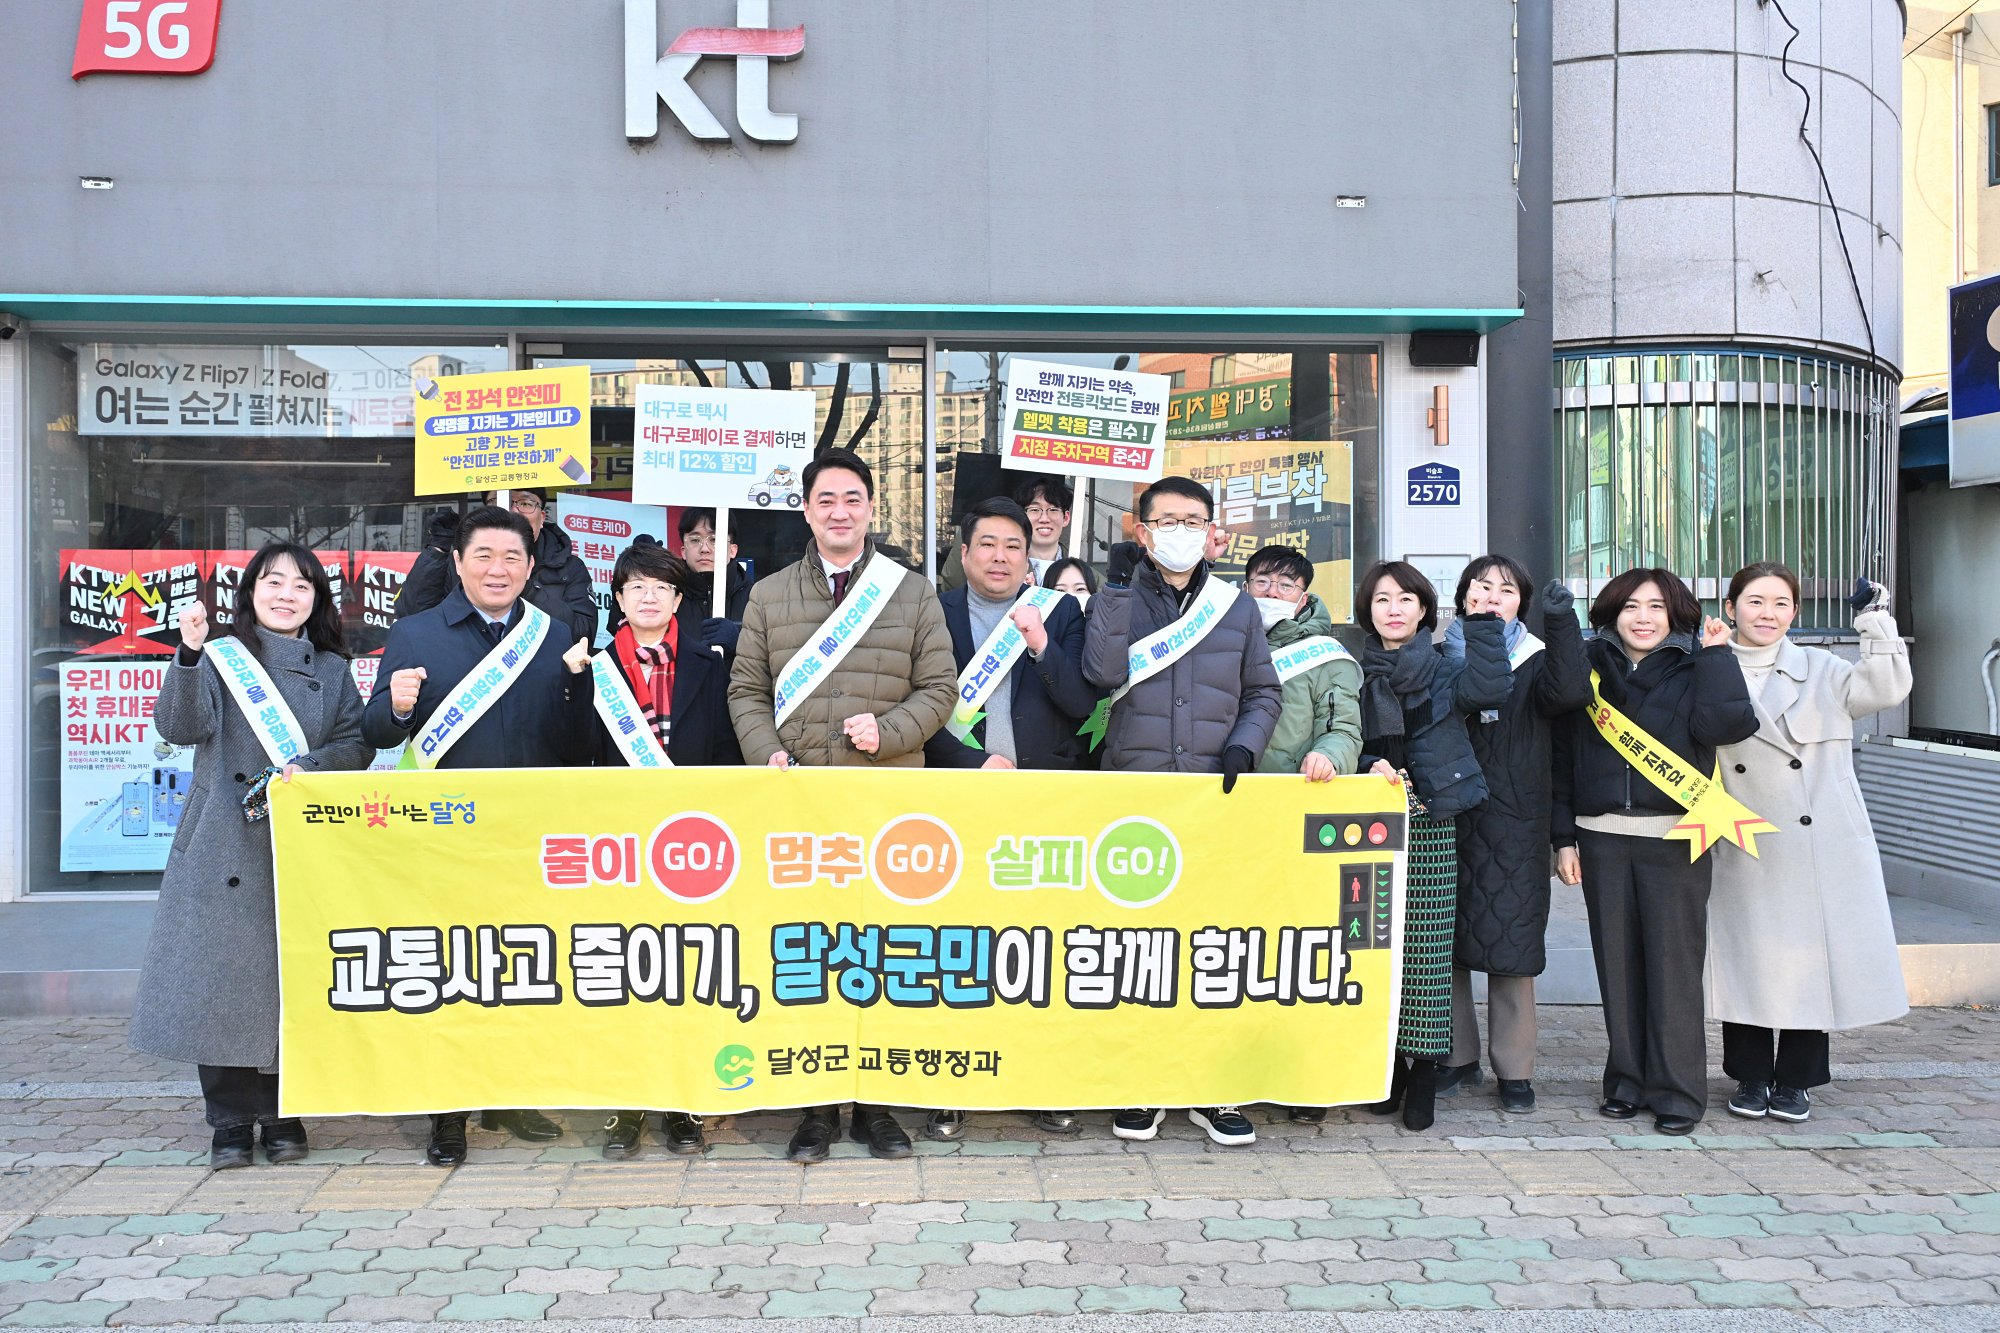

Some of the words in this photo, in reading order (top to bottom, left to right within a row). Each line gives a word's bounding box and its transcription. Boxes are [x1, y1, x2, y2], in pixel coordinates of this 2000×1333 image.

[104, 0, 189, 59] 5G
[625, 0, 804, 142] kt
[95, 359, 178, 385] Galaxy
[183, 364, 195, 382] Z
[200, 364, 249, 388] Flip7
[1039, 371, 1064, 388] 함께
[1067, 375, 1105, 392] 지키는
[1108, 379, 1136, 397] 약속,
[96, 386, 170, 425] 여는
[179, 391, 242, 425] 순간
[248, 393, 343, 427] 펼쳐지는
[444, 390, 462, 412] 전
[466, 387, 501, 411] 좌석
[506, 383, 561, 407] 안전띠
[644, 400, 692, 419] 대구로
[697, 403, 728, 421] 택시
[1016, 387, 1054, 404] 안전한
[1057, 390, 1127, 413] 전동킥보드
[1131, 400, 1160, 416] 문화!
[432, 416, 470, 434] 생명을
[472, 413, 508, 430] 지키는
[511, 409, 573, 428] 기본입니다
[1023, 411, 1053, 432] 헬멧
[1058, 415, 1103, 436] 착용은
[1108, 421, 1138, 440] 필수
[465, 435, 491, 452] 고향
[495, 435, 519, 450] 가는
[523, 433, 535, 447] 길
[643, 425, 739, 446] 대구로페이로
[743, 429, 806, 449] 결제하면
[642, 450, 675, 469] 최대
[682, 453, 717, 470] 12%
[720, 453, 752, 472] 할인
[1019, 438, 1049, 456] 지정
[1052, 441, 1110, 464] 주차구역
[1113, 447, 1146, 467] 준수!
[1190, 463, 1236, 481] 화원KT
[1240, 458, 1265, 475] 만의
[1269, 454, 1294, 469] 특별
[1298, 451, 1324, 465] 행사
[475, 474, 498, 484] 달성군
[500, 472, 538, 482] 교통행정과
[1410, 484, 1458, 502] 2570
[569, 517, 589, 530] 365
[592, 519, 626, 535] 폰케어
[584, 542, 615, 561] 분실
[170, 562, 197, 581] 맞아
[216, 562, 246, 587] KT
[70, 585, 126, 618] NEW
[171, 579, 197, 597] 바로
[364, 586, 396, 614] NE
[70, 610, 127, 635] GALAXY
[363, 611, 398, 629] GAL
[818, 581, 881, 658] 교통안전을
[1150, 599, 1216, 661] 교통안전을
[66, 669, 110, 692] 우리
[119, 669, 162, 691] 아이
[67, 695, 87, 718] 첫
[1618, 730, 1647, 757] 함께
[1642, 750, 1686, 787] 지켜요
[302, 803, 361, 824] 군민이
[429, 801, 476, 825] 달성
[543, 836, 637, 885] 줄이
[663, 839, 728, 872] GO!
[769, 838, 863, 886] 멈추
[885, 841, 949, 875] GO!
[988, 838, 1083, 886] 살피
[1106, 844, 1169, 877] GO!
[329, 925, 562, 1013] 교통사고
[571, 923, 759, 1023] 줄이기,
[772, 923, 1051, 1008] 달성군민이
[1064, 925, 1178, 1008] 함께
[1191, 925, 1362, 1007] 합니다.
[767, 1044, 850, 1076] 달성군
[858, 1045, 1002, 1078] 교통행정과
